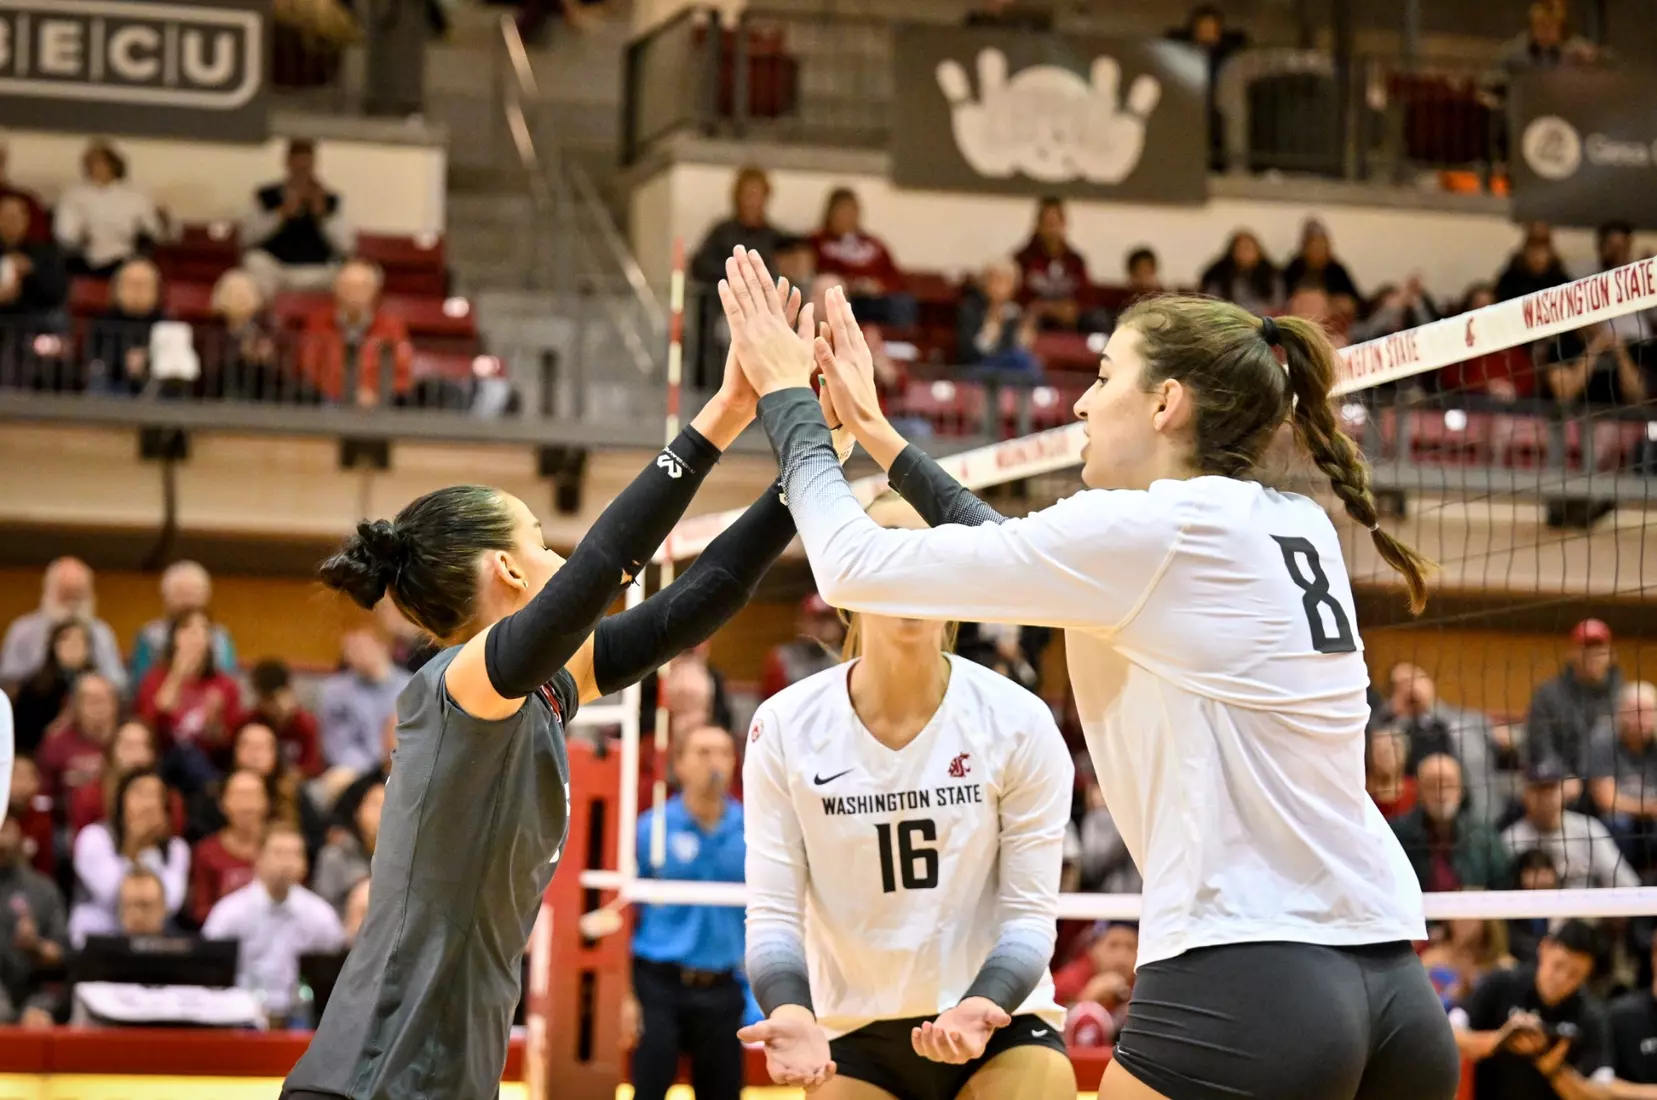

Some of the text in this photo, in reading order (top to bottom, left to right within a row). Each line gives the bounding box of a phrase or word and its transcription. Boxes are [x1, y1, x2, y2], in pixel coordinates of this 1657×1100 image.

[1522, 260, 1655, 329] WASHINGTON STATE
[1268, 533, 1357, 654] 8
[821, 784, 982, 816] WASHINGTON STATE
[873, 818, 939, 893] 16
